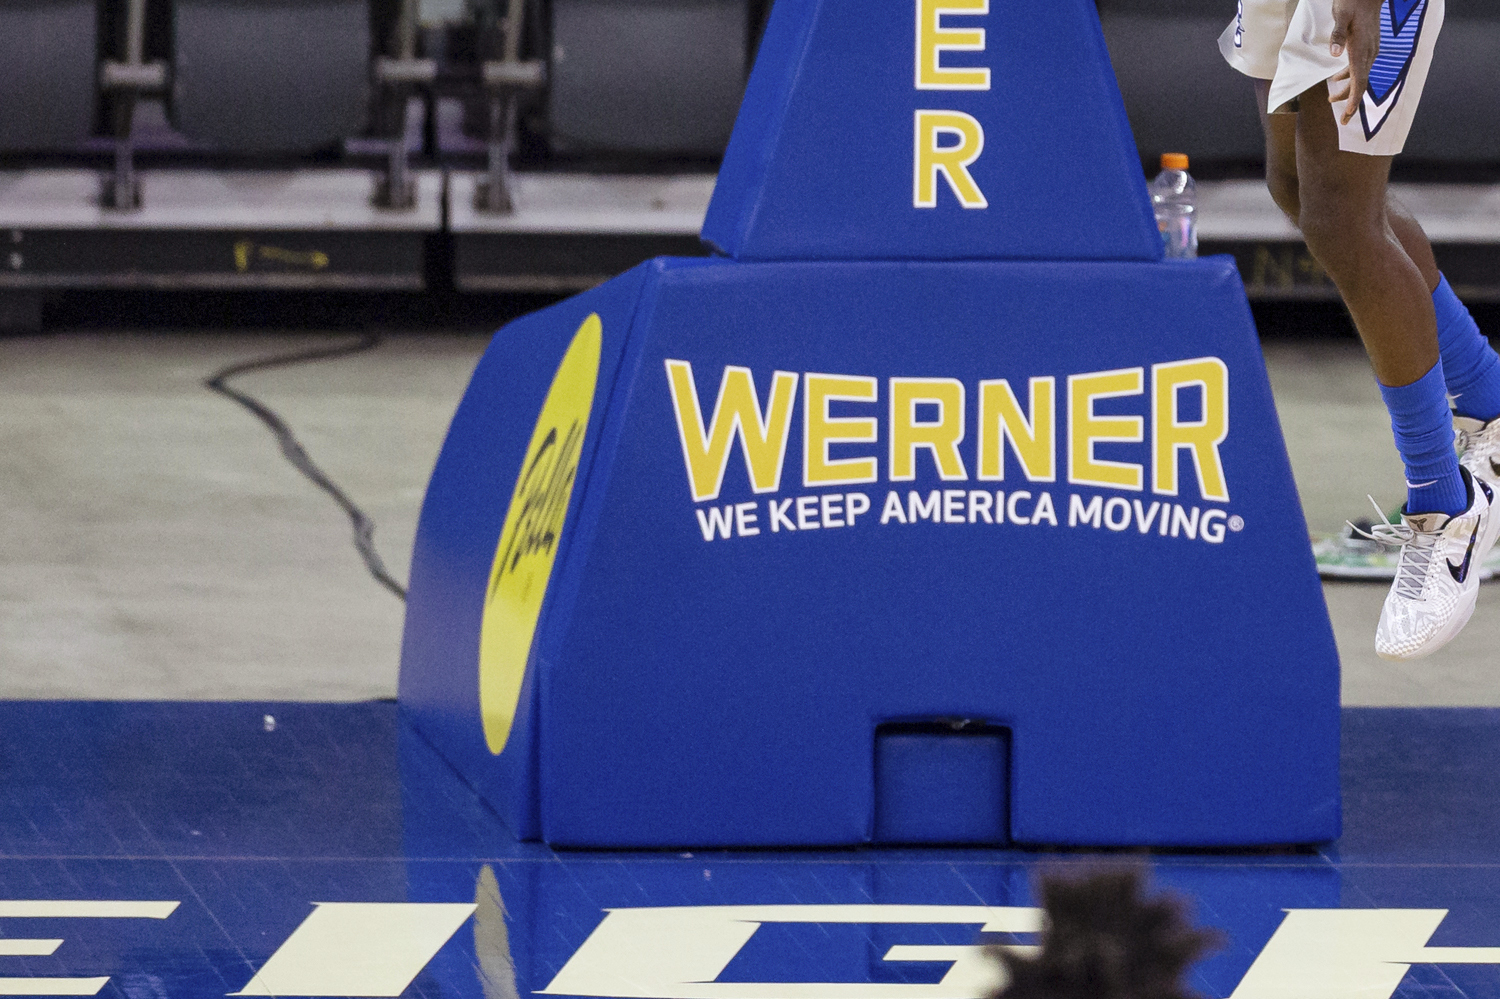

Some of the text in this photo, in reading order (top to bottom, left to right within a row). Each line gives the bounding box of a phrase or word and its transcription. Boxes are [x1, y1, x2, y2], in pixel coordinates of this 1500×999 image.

[664, 356, 1230, 502] WERNER
[696, 501, 760, 542] WE
[769, 492, 871, 533] KEEP
[880, 489, 1058, 527] AMERICA
